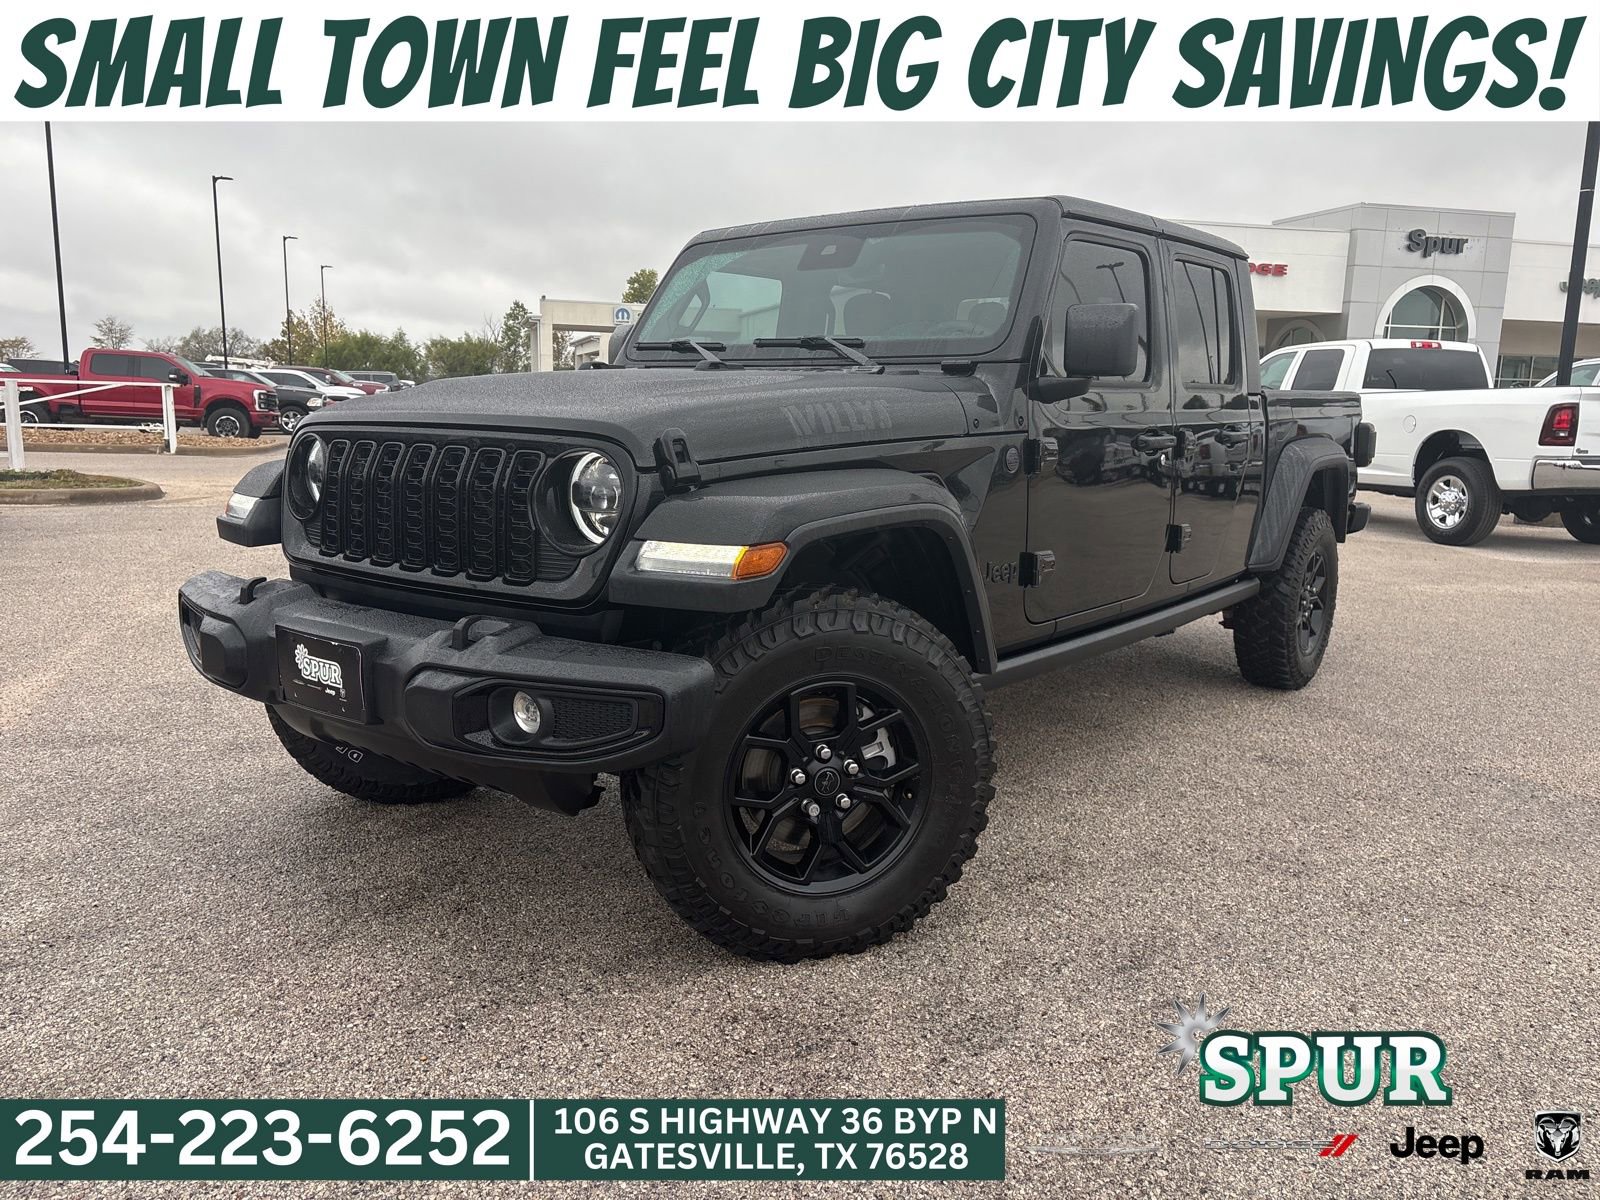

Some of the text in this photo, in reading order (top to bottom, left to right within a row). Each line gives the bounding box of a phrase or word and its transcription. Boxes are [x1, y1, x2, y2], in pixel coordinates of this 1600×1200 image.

[1407, 229, 1468, 257] Spur
[985, 561, 1017, 584] Jeep
[302, 656, 342, 687] SPUR
